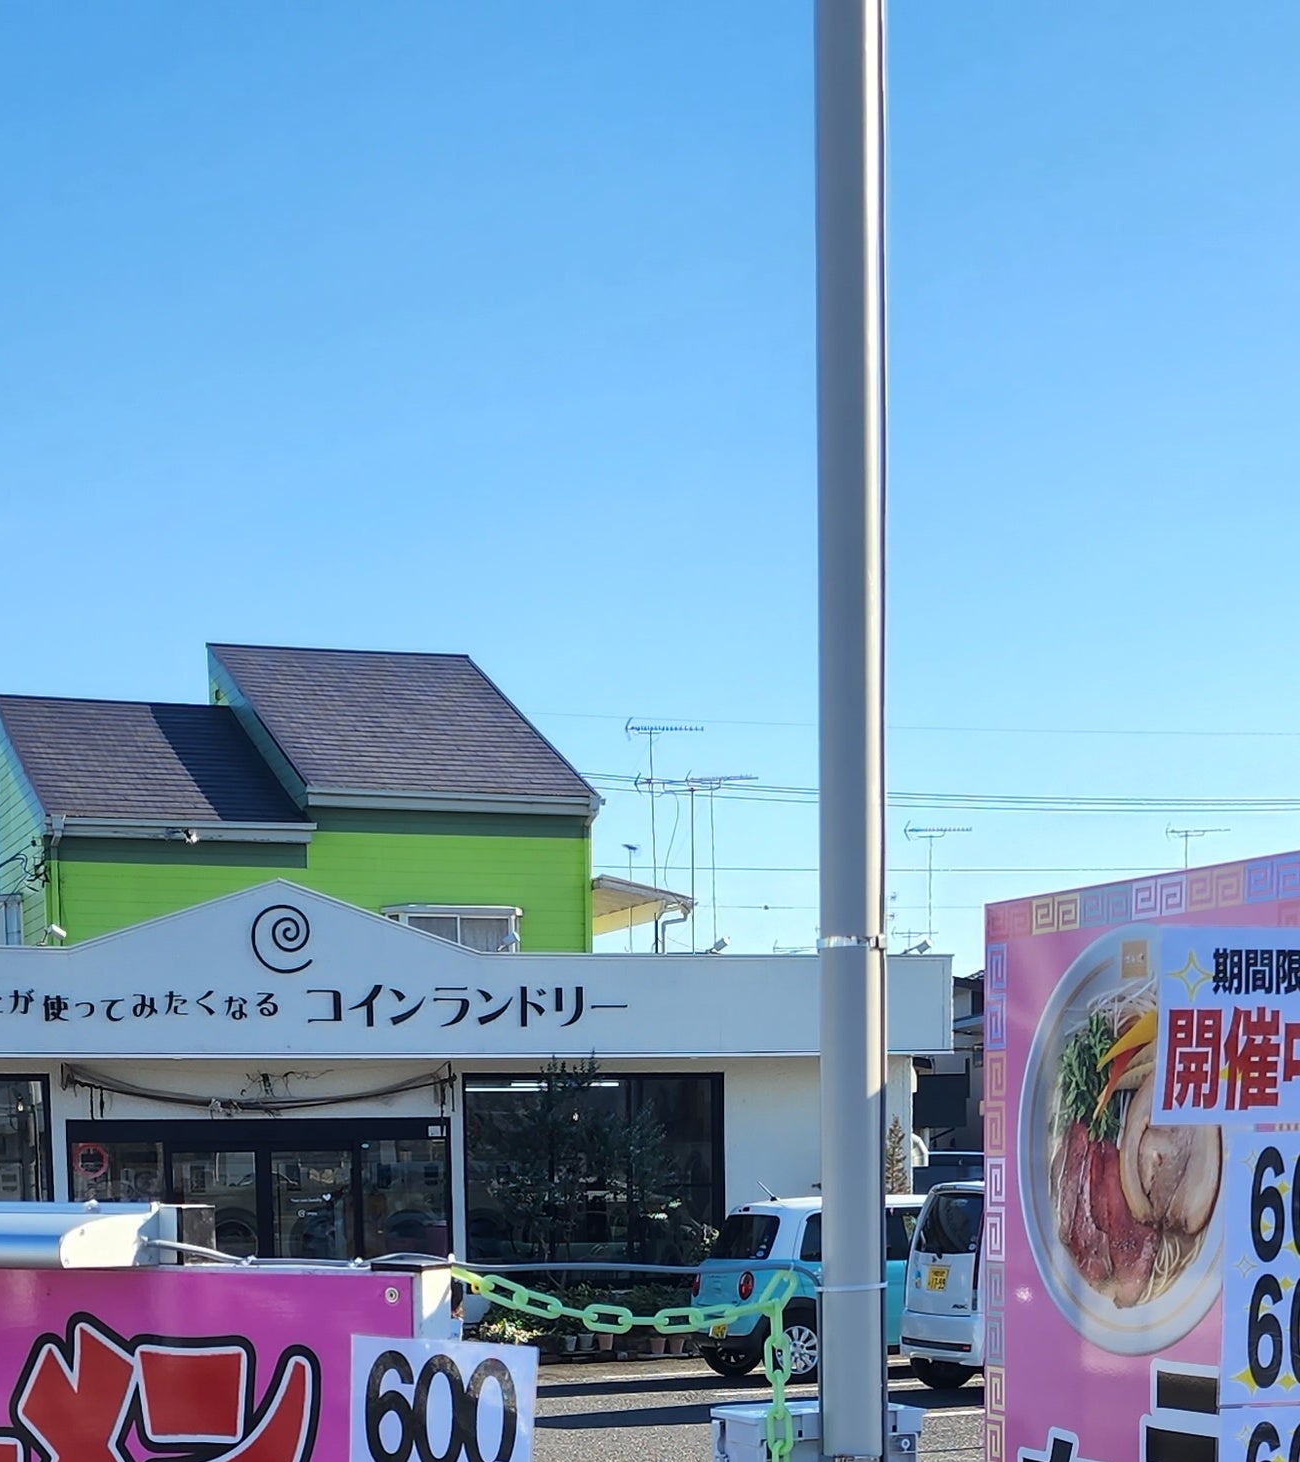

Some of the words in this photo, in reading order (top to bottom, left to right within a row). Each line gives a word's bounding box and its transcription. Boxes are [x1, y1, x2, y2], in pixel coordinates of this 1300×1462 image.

[306, 983, 629, 1029] コインランドリー
